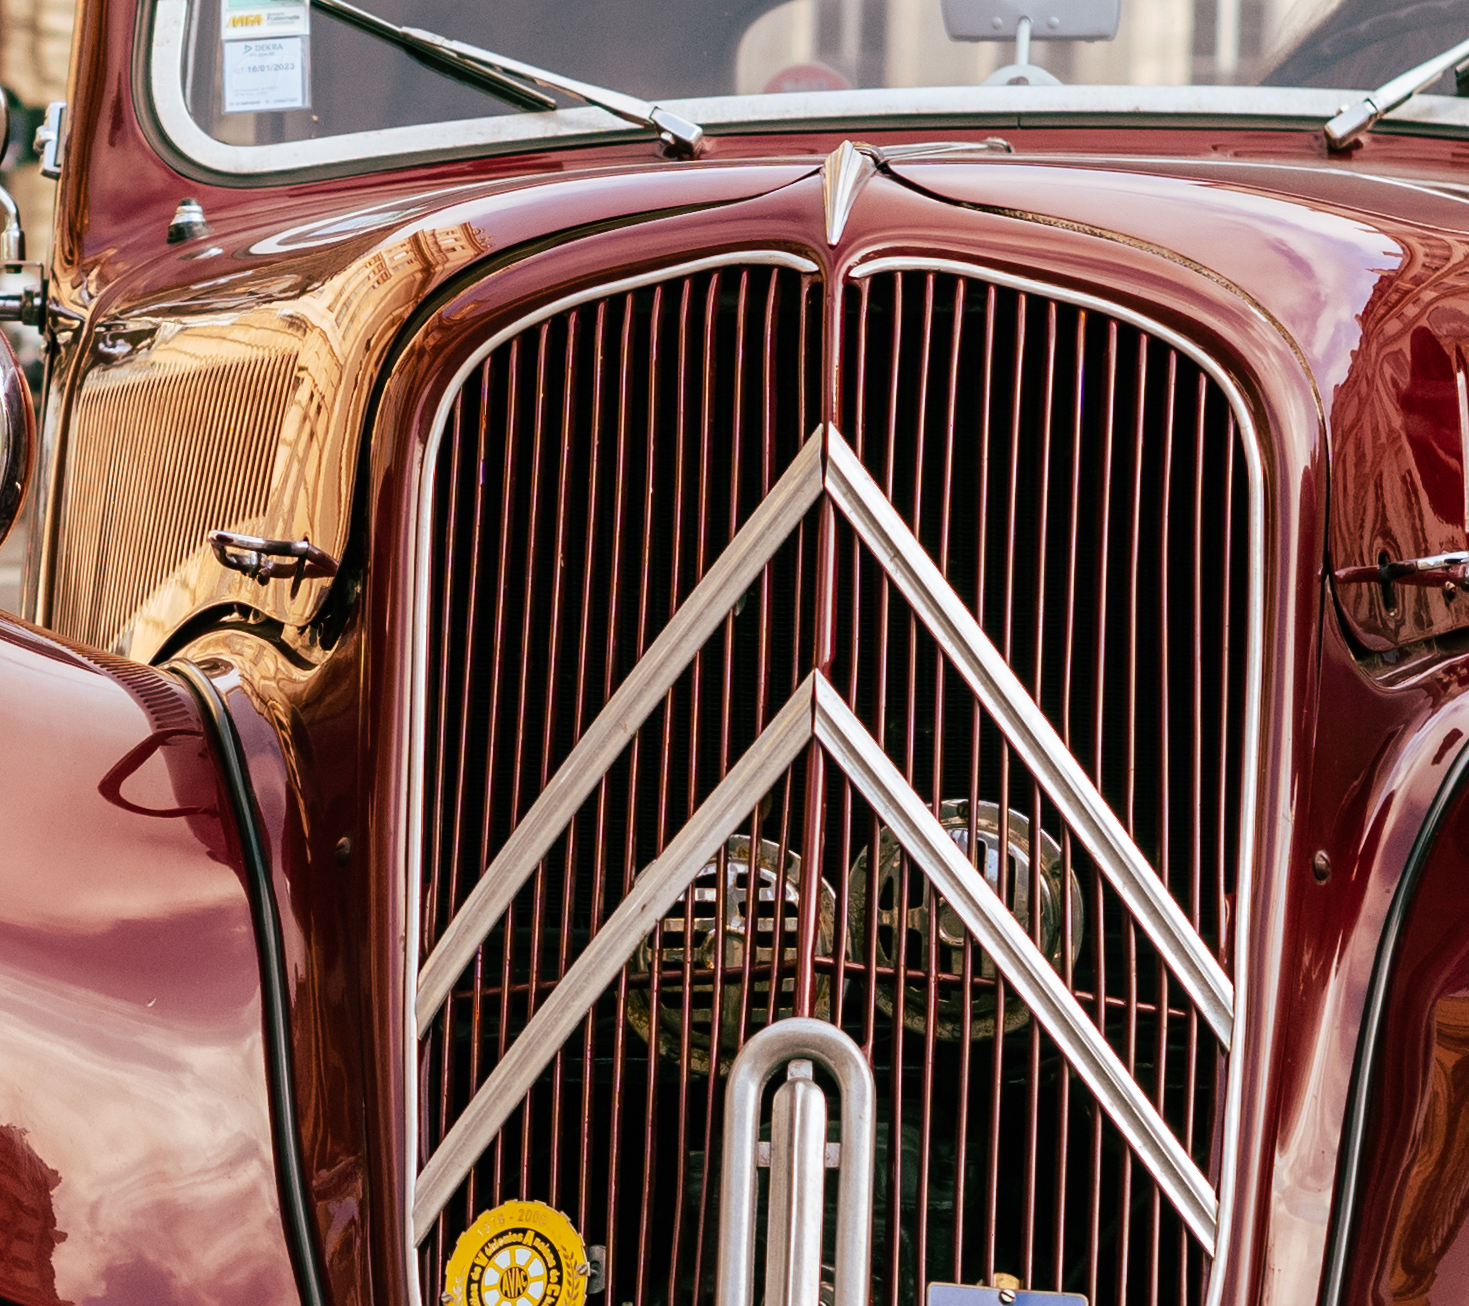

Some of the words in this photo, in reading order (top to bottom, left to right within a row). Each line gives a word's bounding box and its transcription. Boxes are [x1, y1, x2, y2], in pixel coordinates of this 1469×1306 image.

[254, 43, 284, 52] DEKRA
[247, 63, 296, 73] 16/01/2023
[502, 1266, 528, 1298] AVAC
